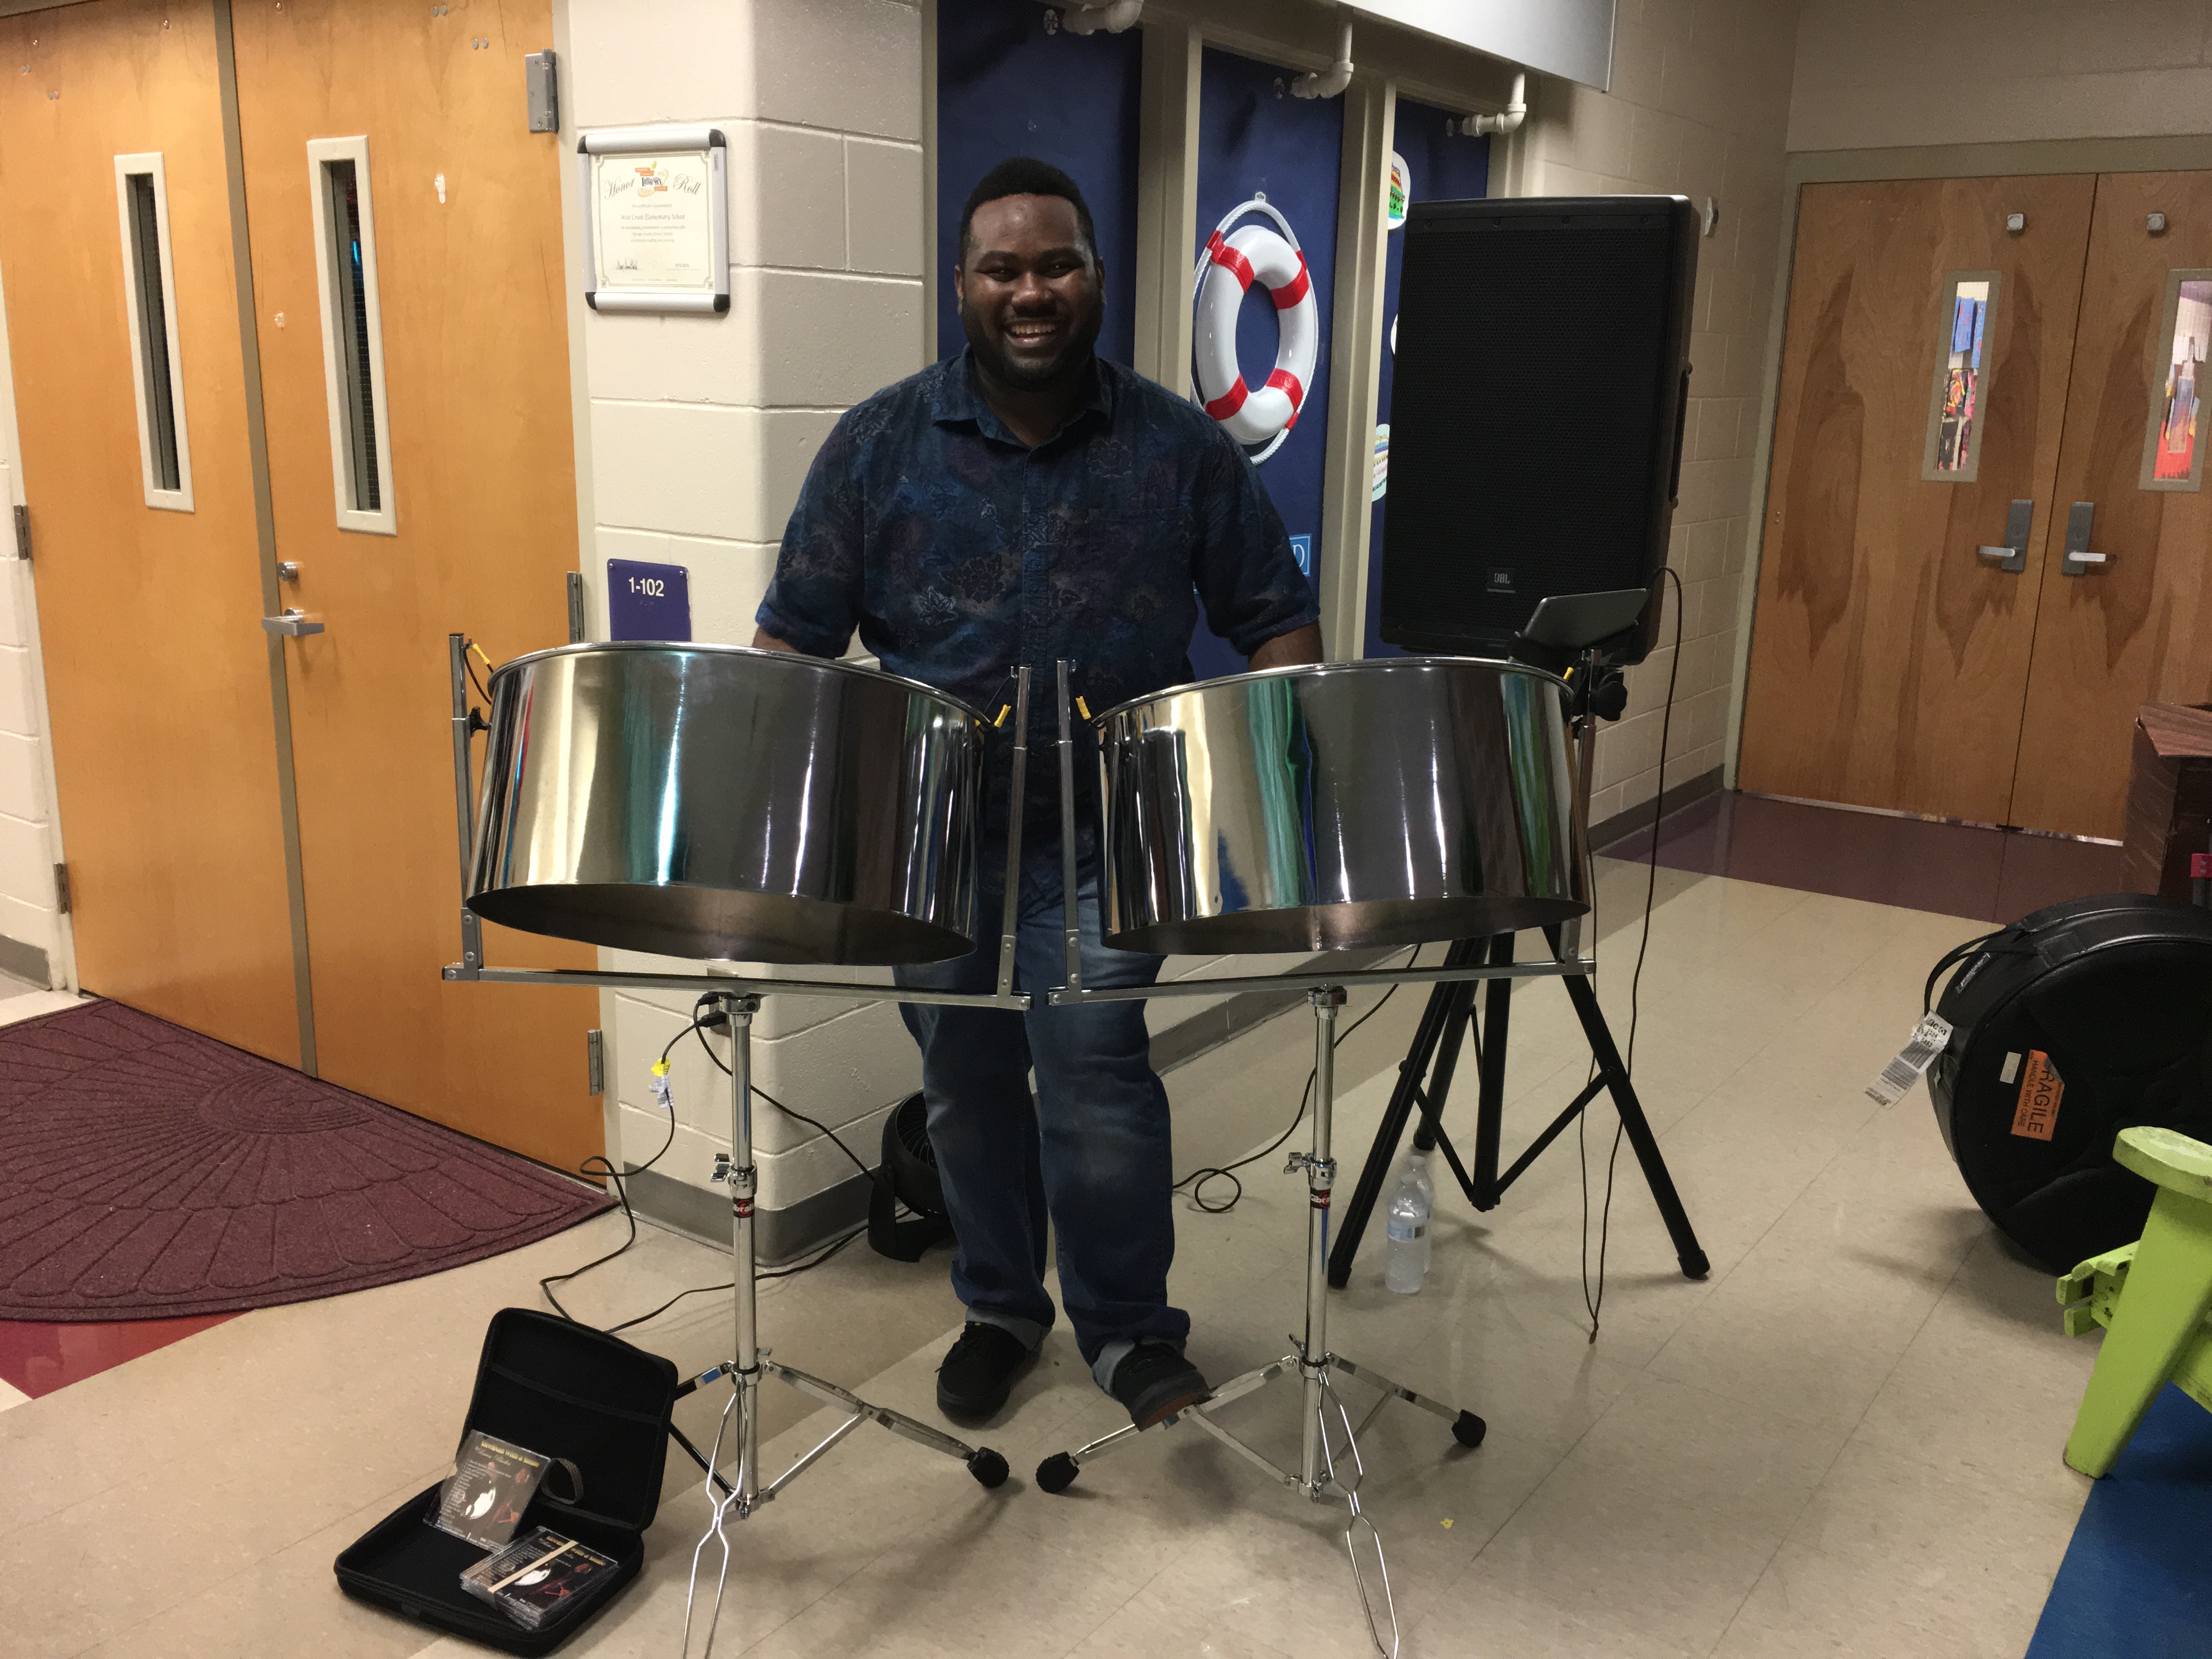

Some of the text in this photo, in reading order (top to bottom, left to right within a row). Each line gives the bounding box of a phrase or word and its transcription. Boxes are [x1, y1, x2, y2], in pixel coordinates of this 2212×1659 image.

[604, 173, 702, 200] Honor Roll
[628, 577, 664, 597] 1-102
[1494, 573, 1510, 584] JBL
[2017, 1060, 2039, 1127] HANDLE WITH CARE
[2027, 1070, 2056, 1134] RAGILE
